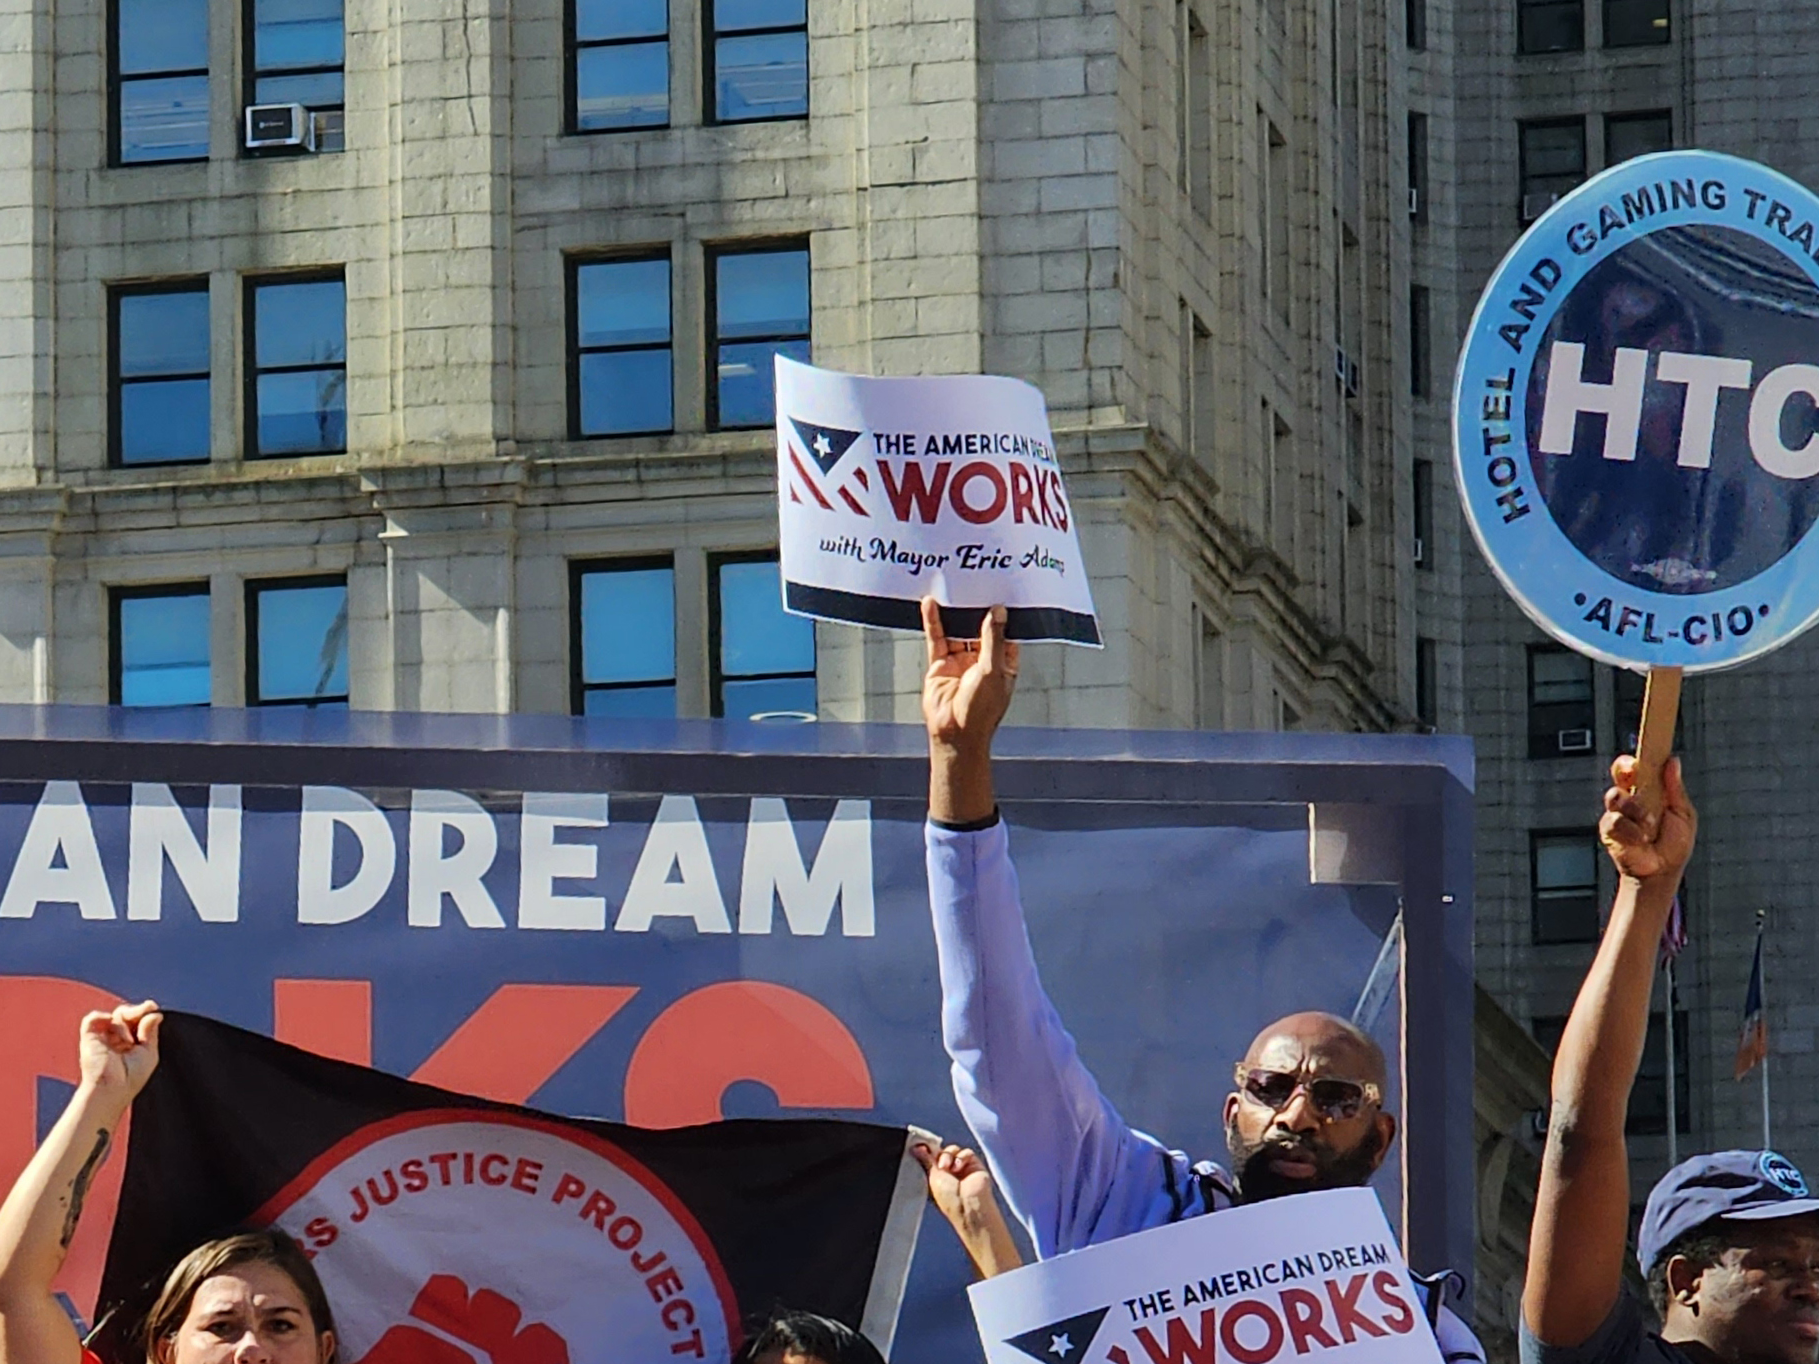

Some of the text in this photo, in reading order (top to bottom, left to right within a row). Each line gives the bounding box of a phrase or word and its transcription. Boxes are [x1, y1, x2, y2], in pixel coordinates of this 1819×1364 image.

[1566, 176, 1726, 257] GAMING
[1498, 256, 1562, 354] AND
[873, 433, 916, 456] THE
[924, 432, 1030, 456] AMERICAN
[1484, 367, 1531, 524] HOTEL
[1538, 340, 1819, 480] HTC
[876, 459, 1070, 534] WORKS
[819, 535, 866, 562] with
[869, 538, 949, 576] Mayor
[955, 544, 1011, 571] Eric
[297, 785, 875, 936] DREAM
[348, 1151, 544, 1224] JUSTICE
[550, 1172, 706, 1360] PROJECT
[1124, 1242, 1391, 1322] THE AMERICAN DREAM
